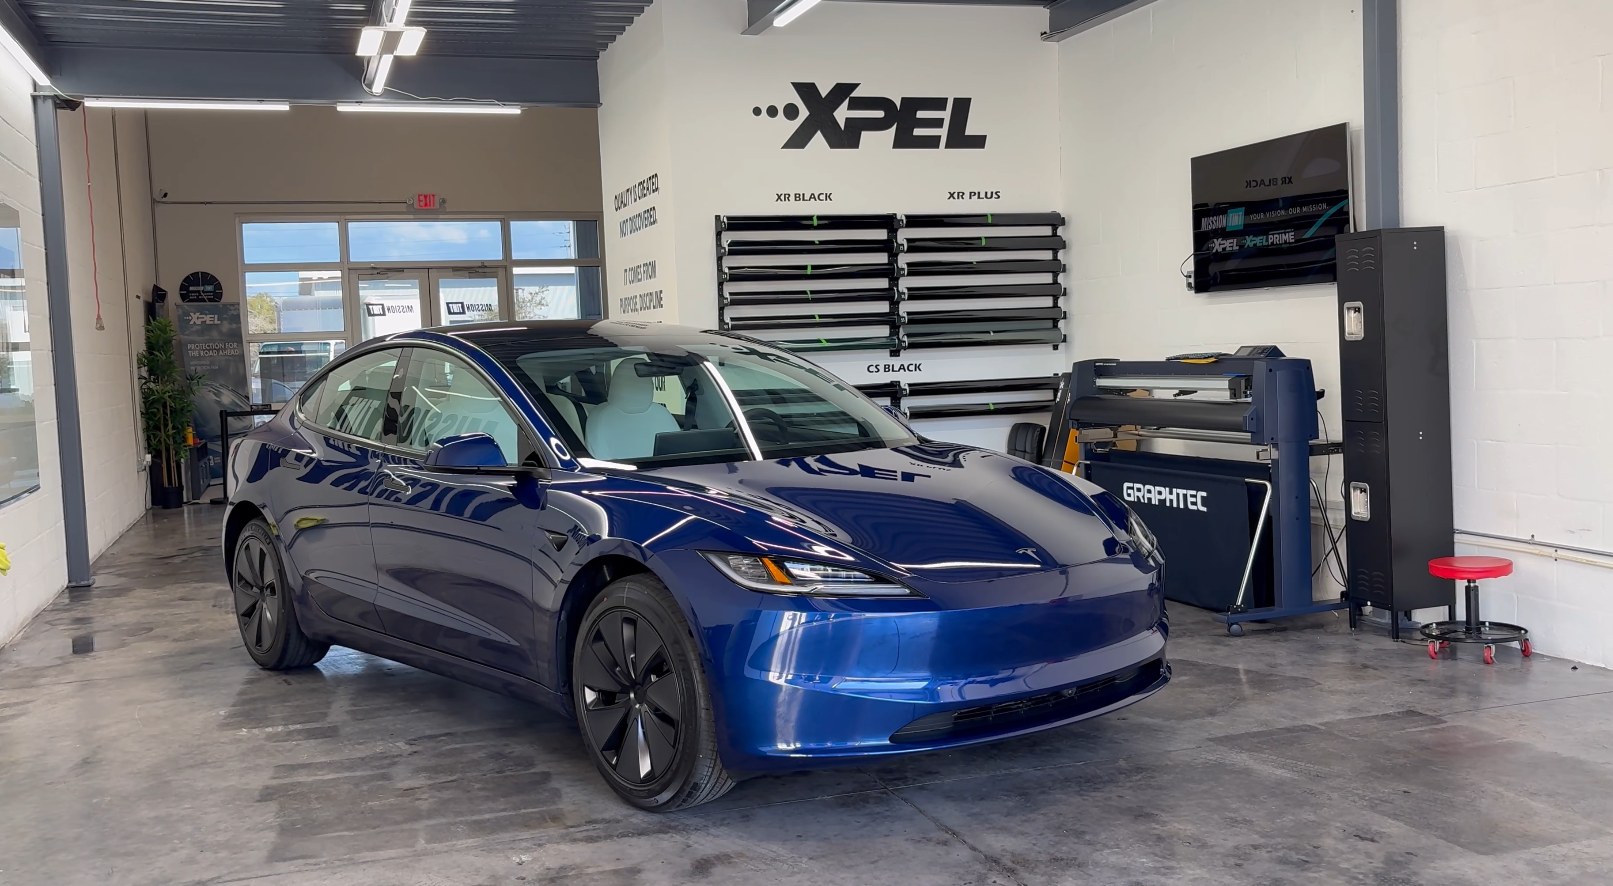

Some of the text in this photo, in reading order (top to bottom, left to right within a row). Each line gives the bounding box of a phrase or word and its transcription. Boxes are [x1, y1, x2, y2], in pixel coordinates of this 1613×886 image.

[780, 81, 988, 150] XPEL
[417, 194, 437, 208] EXIT
[614, 186, 633, 212] QUALITY
[637, 173, 660, 201] CREATED,
[775, 192, 833, 202] XR BLACK
[947, 190, 1001, 200] XR PLUS
[1249, 212, 1265, 221] YOUR
[1288, 207, 1301, 215] OUR
[1302, 202, 1329, 213] MISSION.
[619, 206, 658, 238] NOT DISCOVERED.
[1201, 212, 1243, 231] MISSION TINT
[1213, 238, 1240, 253] XPEL
[623, 260, 657, 286] IT COMES FROM
[639, 290, 663, 312] DISCIPLINE
[189, 312, 221, 325] XPEL
[187, 342, 224, 350] PROTECTION
[866, 363, 923, 373] CS BLACK
[1123, 482, 1207, 512] GRAPHTEC
